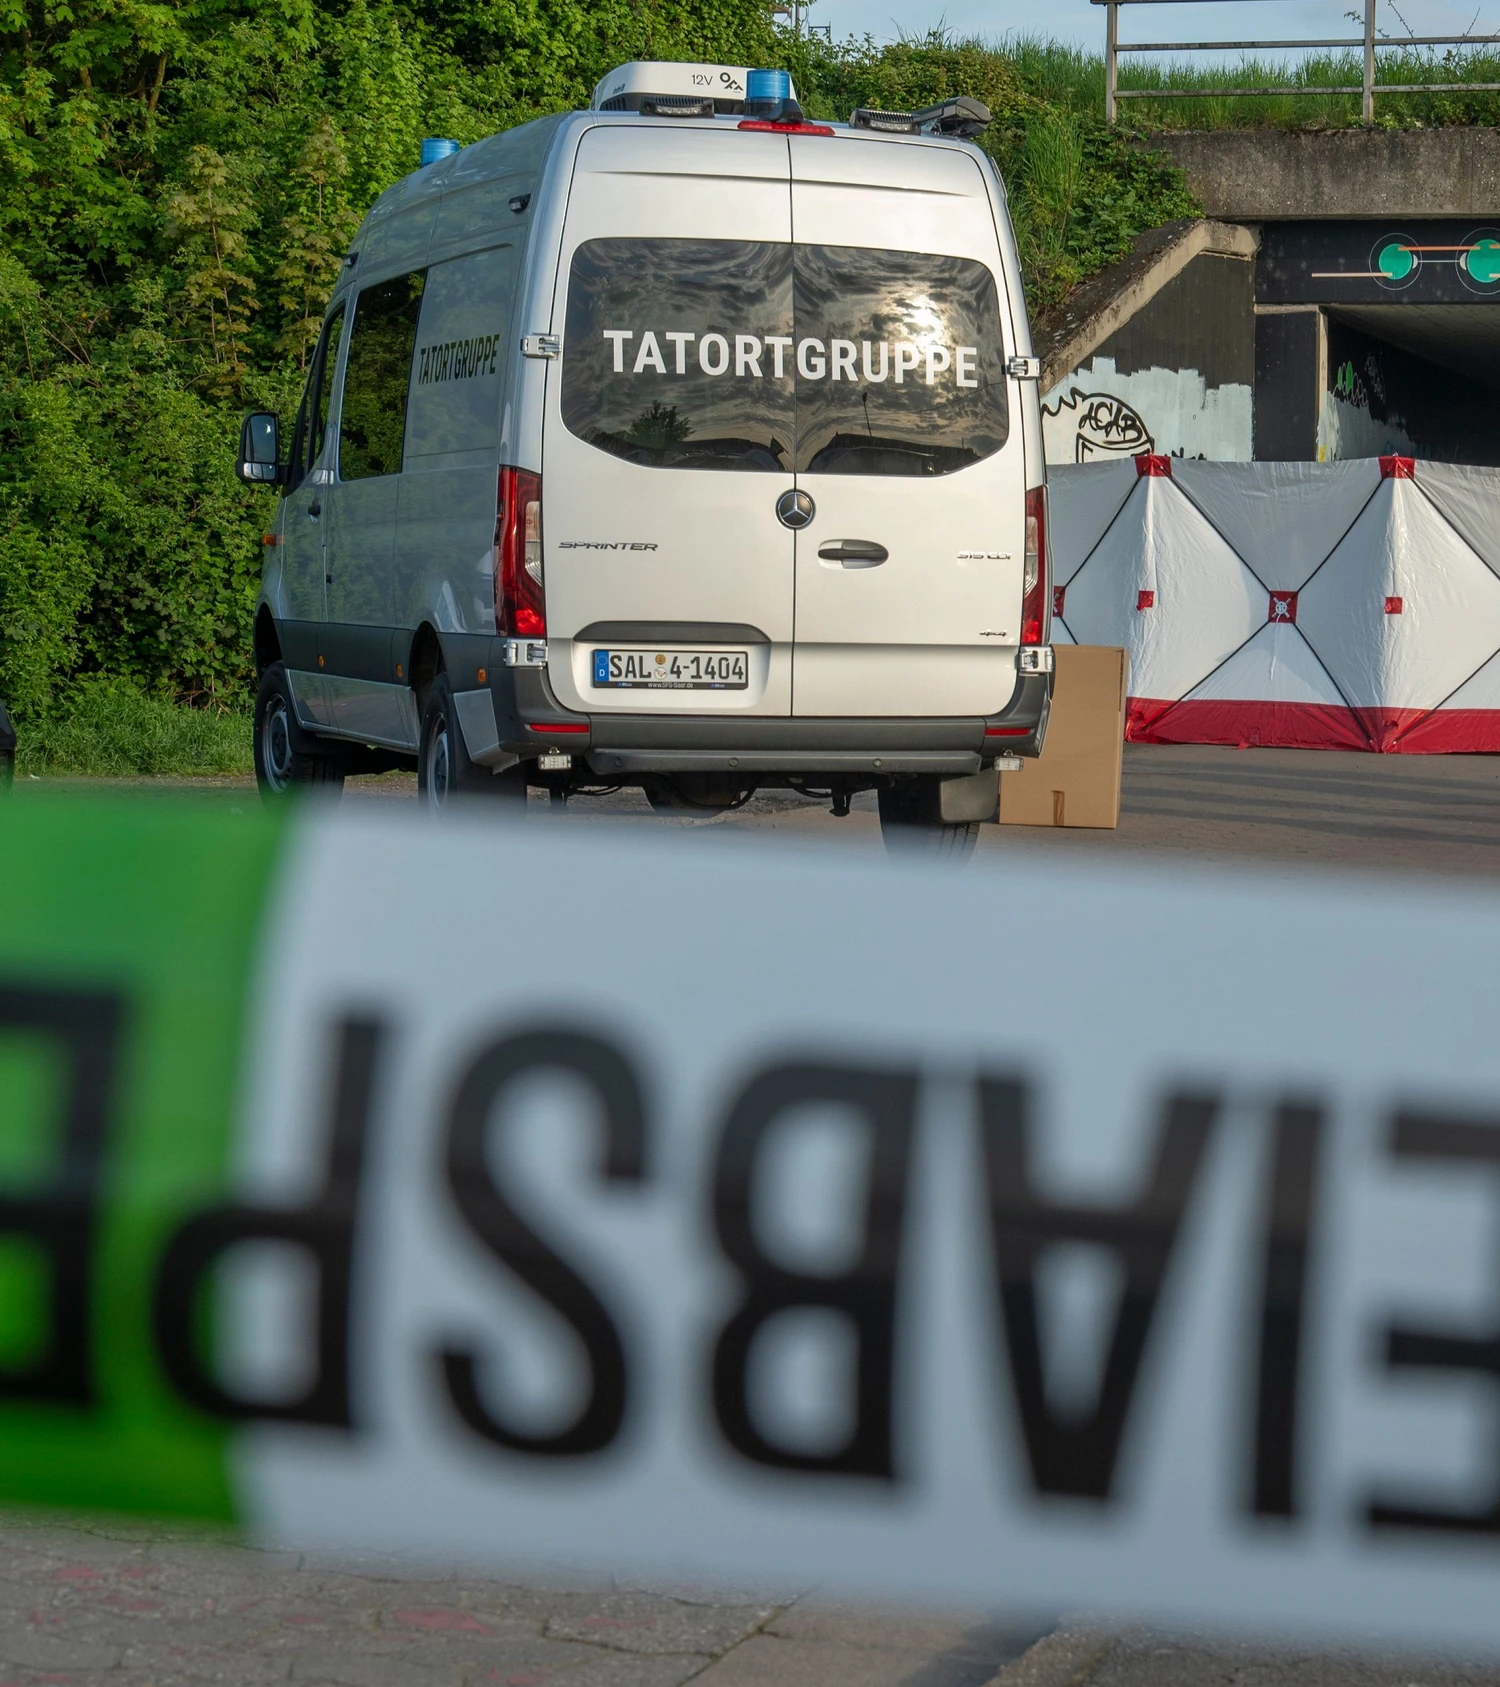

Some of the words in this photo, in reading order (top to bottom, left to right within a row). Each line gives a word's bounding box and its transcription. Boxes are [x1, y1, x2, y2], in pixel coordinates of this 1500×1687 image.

[691, 74, 714, 86] 12V
[417, 333, 501, 386] TATORTGRUPPE
[603, 329, 978, 389] TATORTGRUPPE
[1079, 401, 1144, 444] ACAB
[558, 541, 659, 551] SPRINTER
[599, 668, 605, 677] D
[610, 655, 652, 679] SAL
[670, 656, 744, 680] 4-1404
